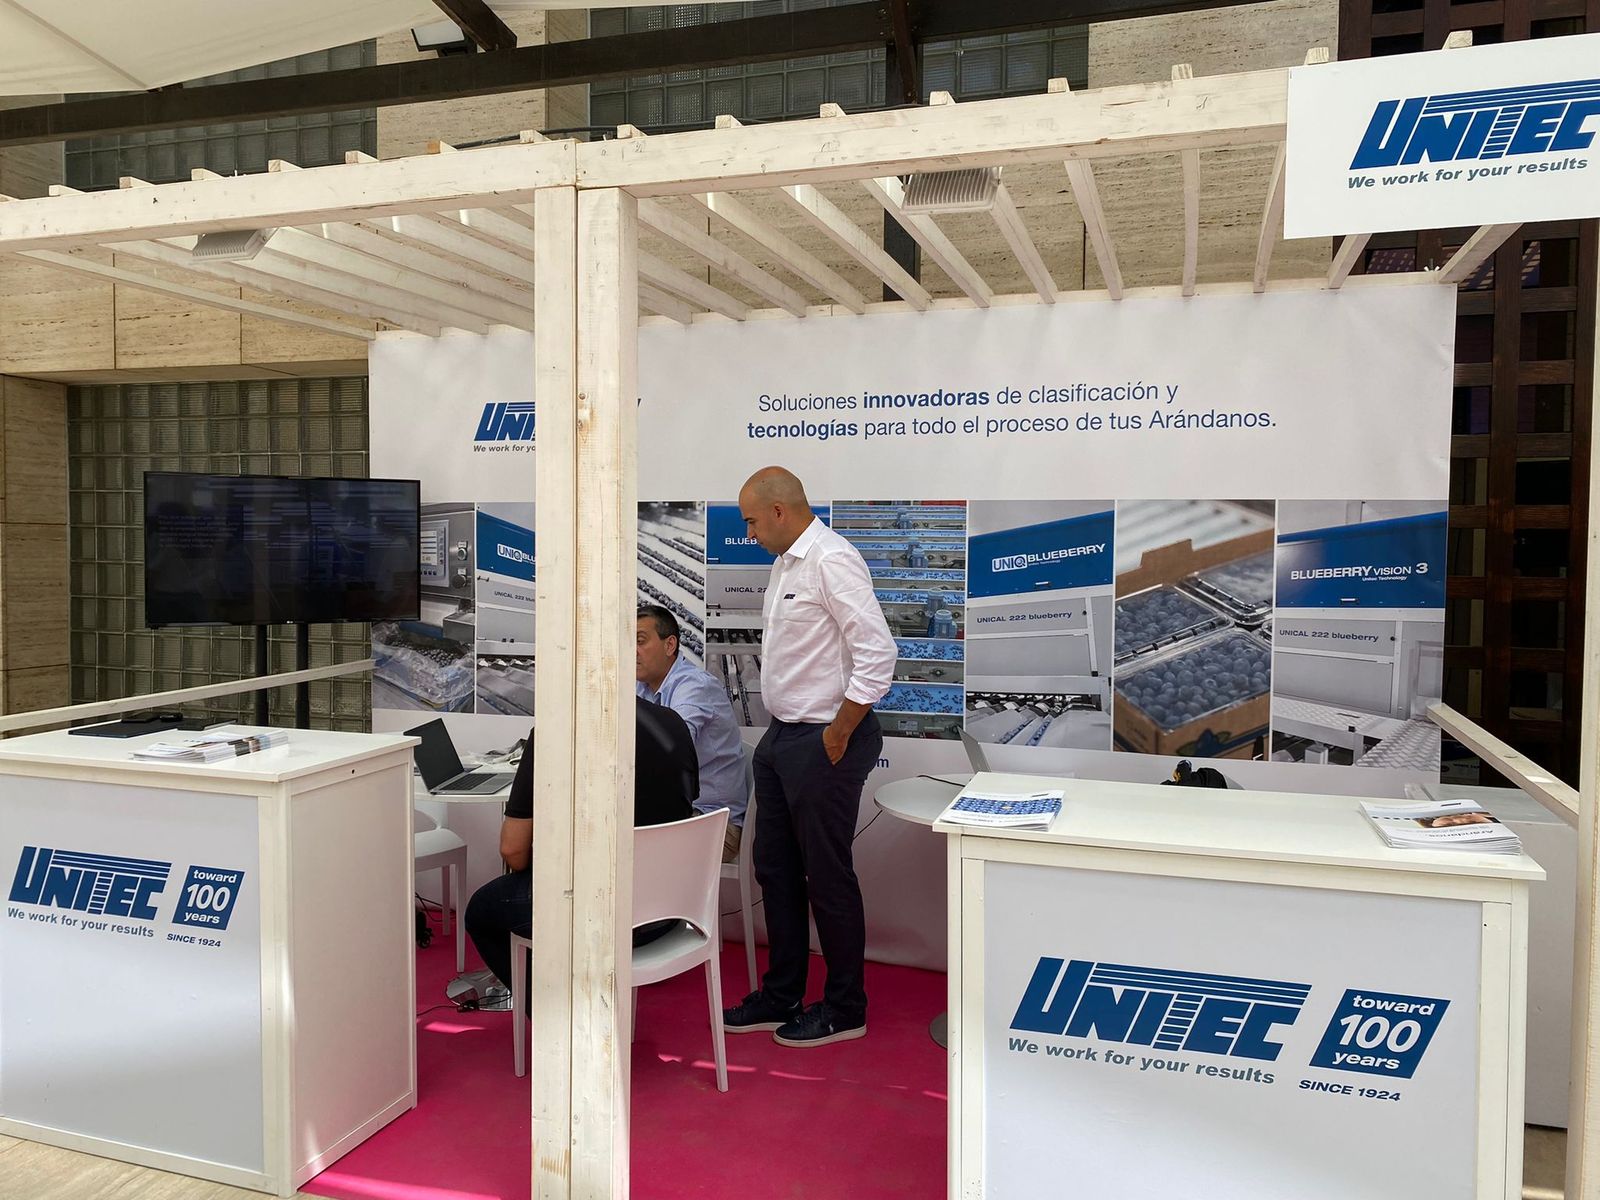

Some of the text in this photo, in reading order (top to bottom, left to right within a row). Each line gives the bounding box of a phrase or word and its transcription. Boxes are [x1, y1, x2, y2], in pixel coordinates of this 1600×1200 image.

[1349, 78, 1600, 170] UNITEC
[1348, 157, 1588, 189] We work for your results
[758, 381, 1179, 413] Soluciones innovadoras de clasificación y
[473, 401, 536, 442] UNI
[747, 408, 1277, 441] tecnologías para todo el proceso de tus Arándanos.
[511, 444, 525, 452] for
[526, 445, 536, 454] yo
[724, 537, 758, 545] BLUEB
[992, 543, 1105, 571] UNIQ BLUEBERRY
[1290, 562, 1429, 579] BLUEBERRY VISION 3
[977, 611, 1073, 624] UNICAL 222 blueberry
[1279, 629, 1379, 643] UNICAL 222 blueberry
[8, 845, 173, 921] UNITEC
[193, 869, 238, 884] toward
[186, 884, 231, 912] 100
[7, 907, 155, 938] We work for your results
[183, 911, 221, 925] years
[167, 933, 222, 948] SINCE 1924
[1009, 956, 1313, 1062] UNITEC
[1352, 994, 1436, 1016] toward
[1338, 1014, 1424, 1053] 100
[1008, 1037, 1276, 1085] We work for your results
[1332, 1051, 1401, 1071] years
[1299, 1079, 1402, 1102] SINCE 1924
